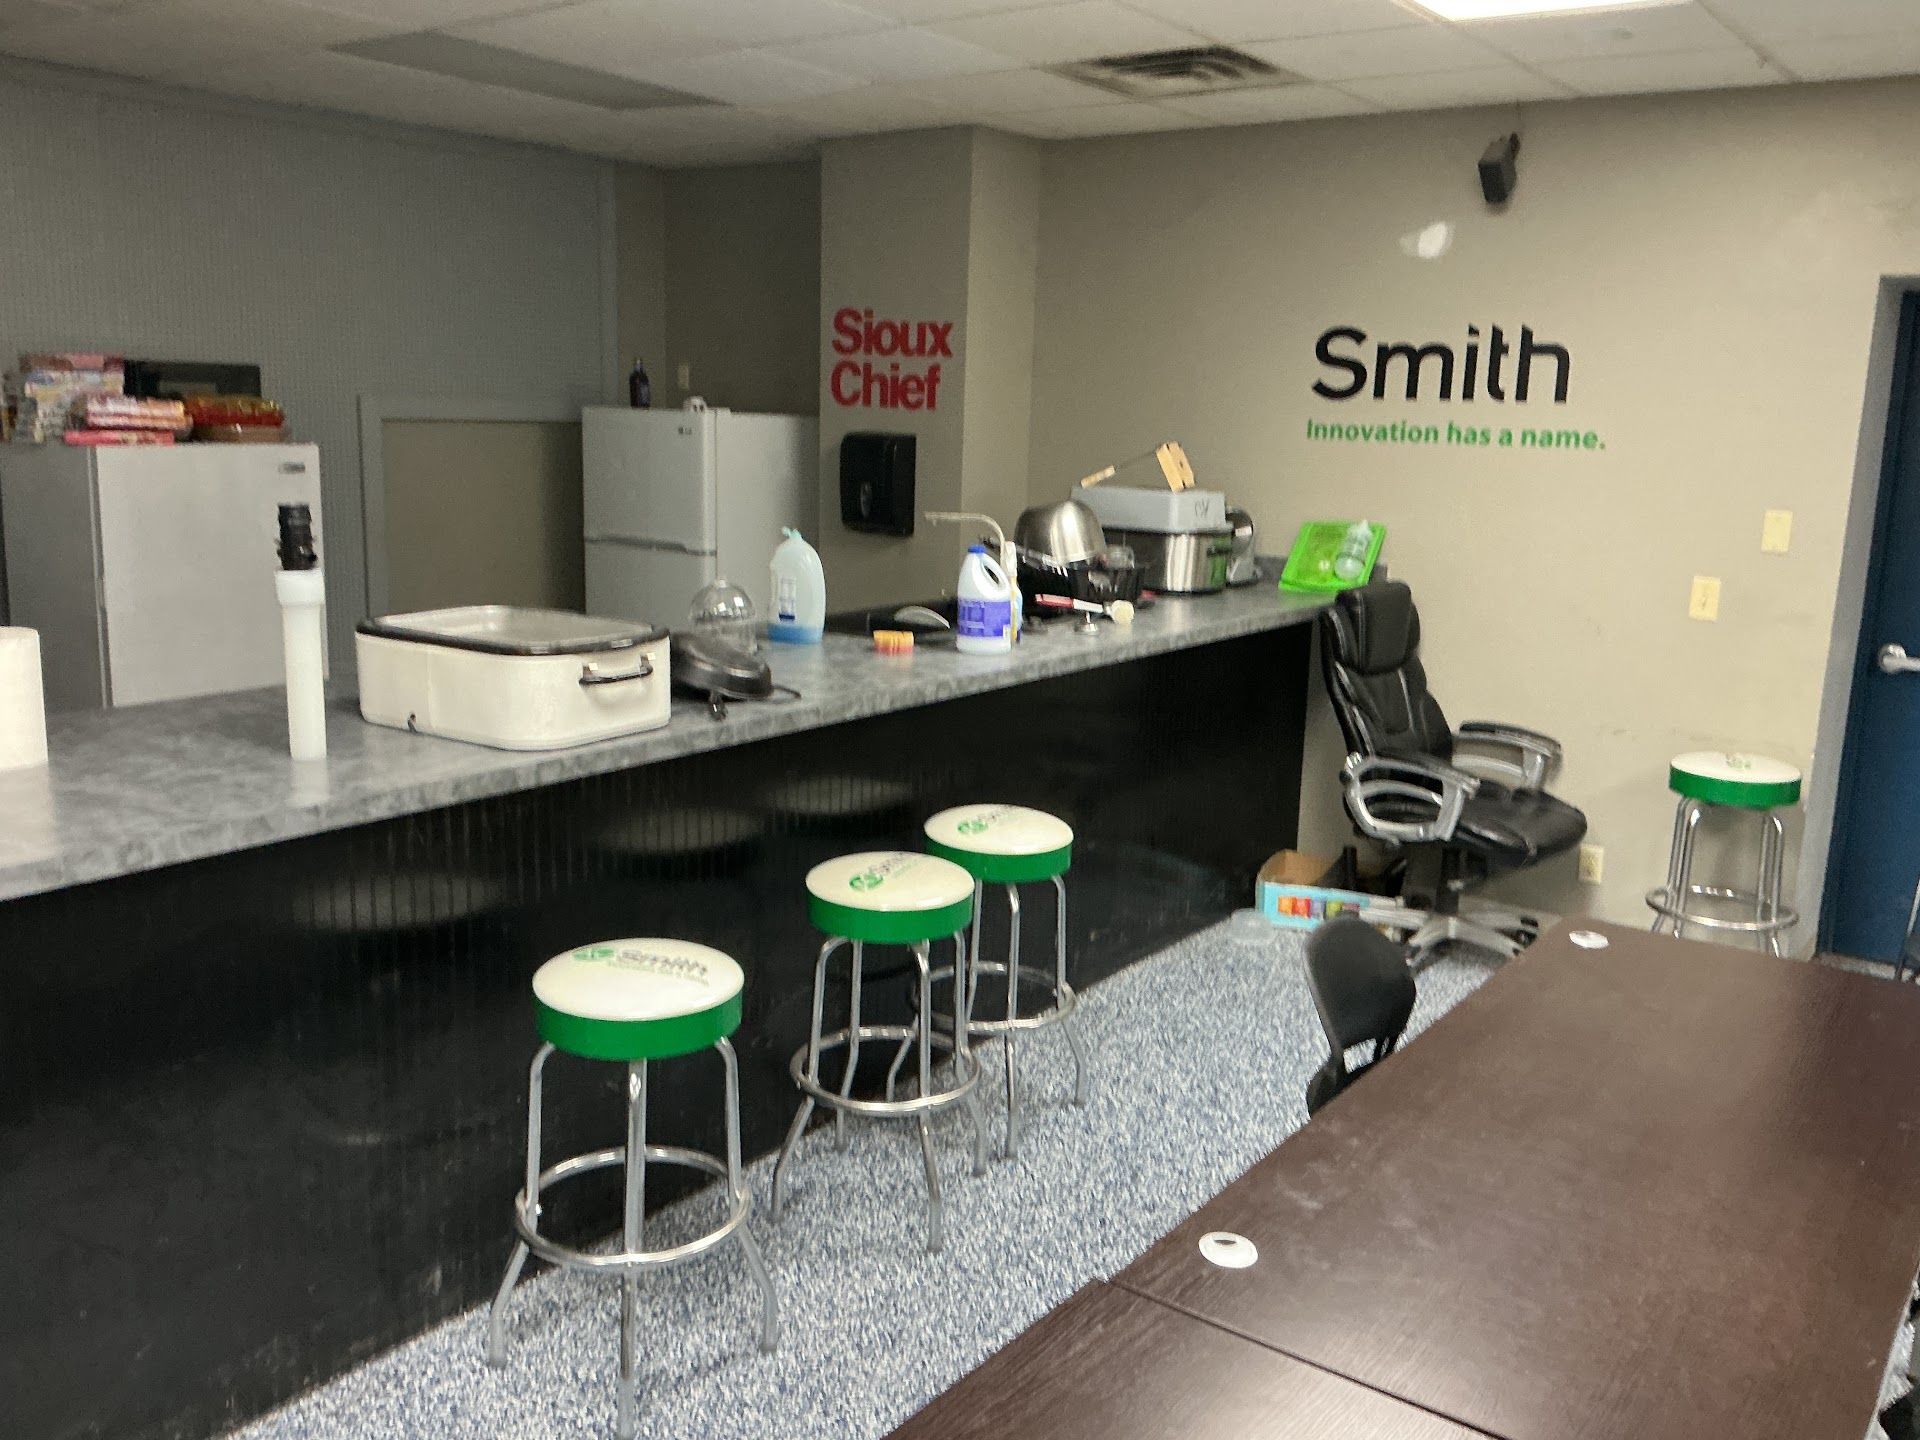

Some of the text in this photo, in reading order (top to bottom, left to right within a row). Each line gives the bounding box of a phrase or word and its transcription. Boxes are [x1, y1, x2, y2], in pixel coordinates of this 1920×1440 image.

[832, 307, 953, 357] Sioux
[831, 361, 941, 410] Chief
[1311, 323, 1571, 405] Smith
[1306, 418, 1607, 451] Innovation has a name.
